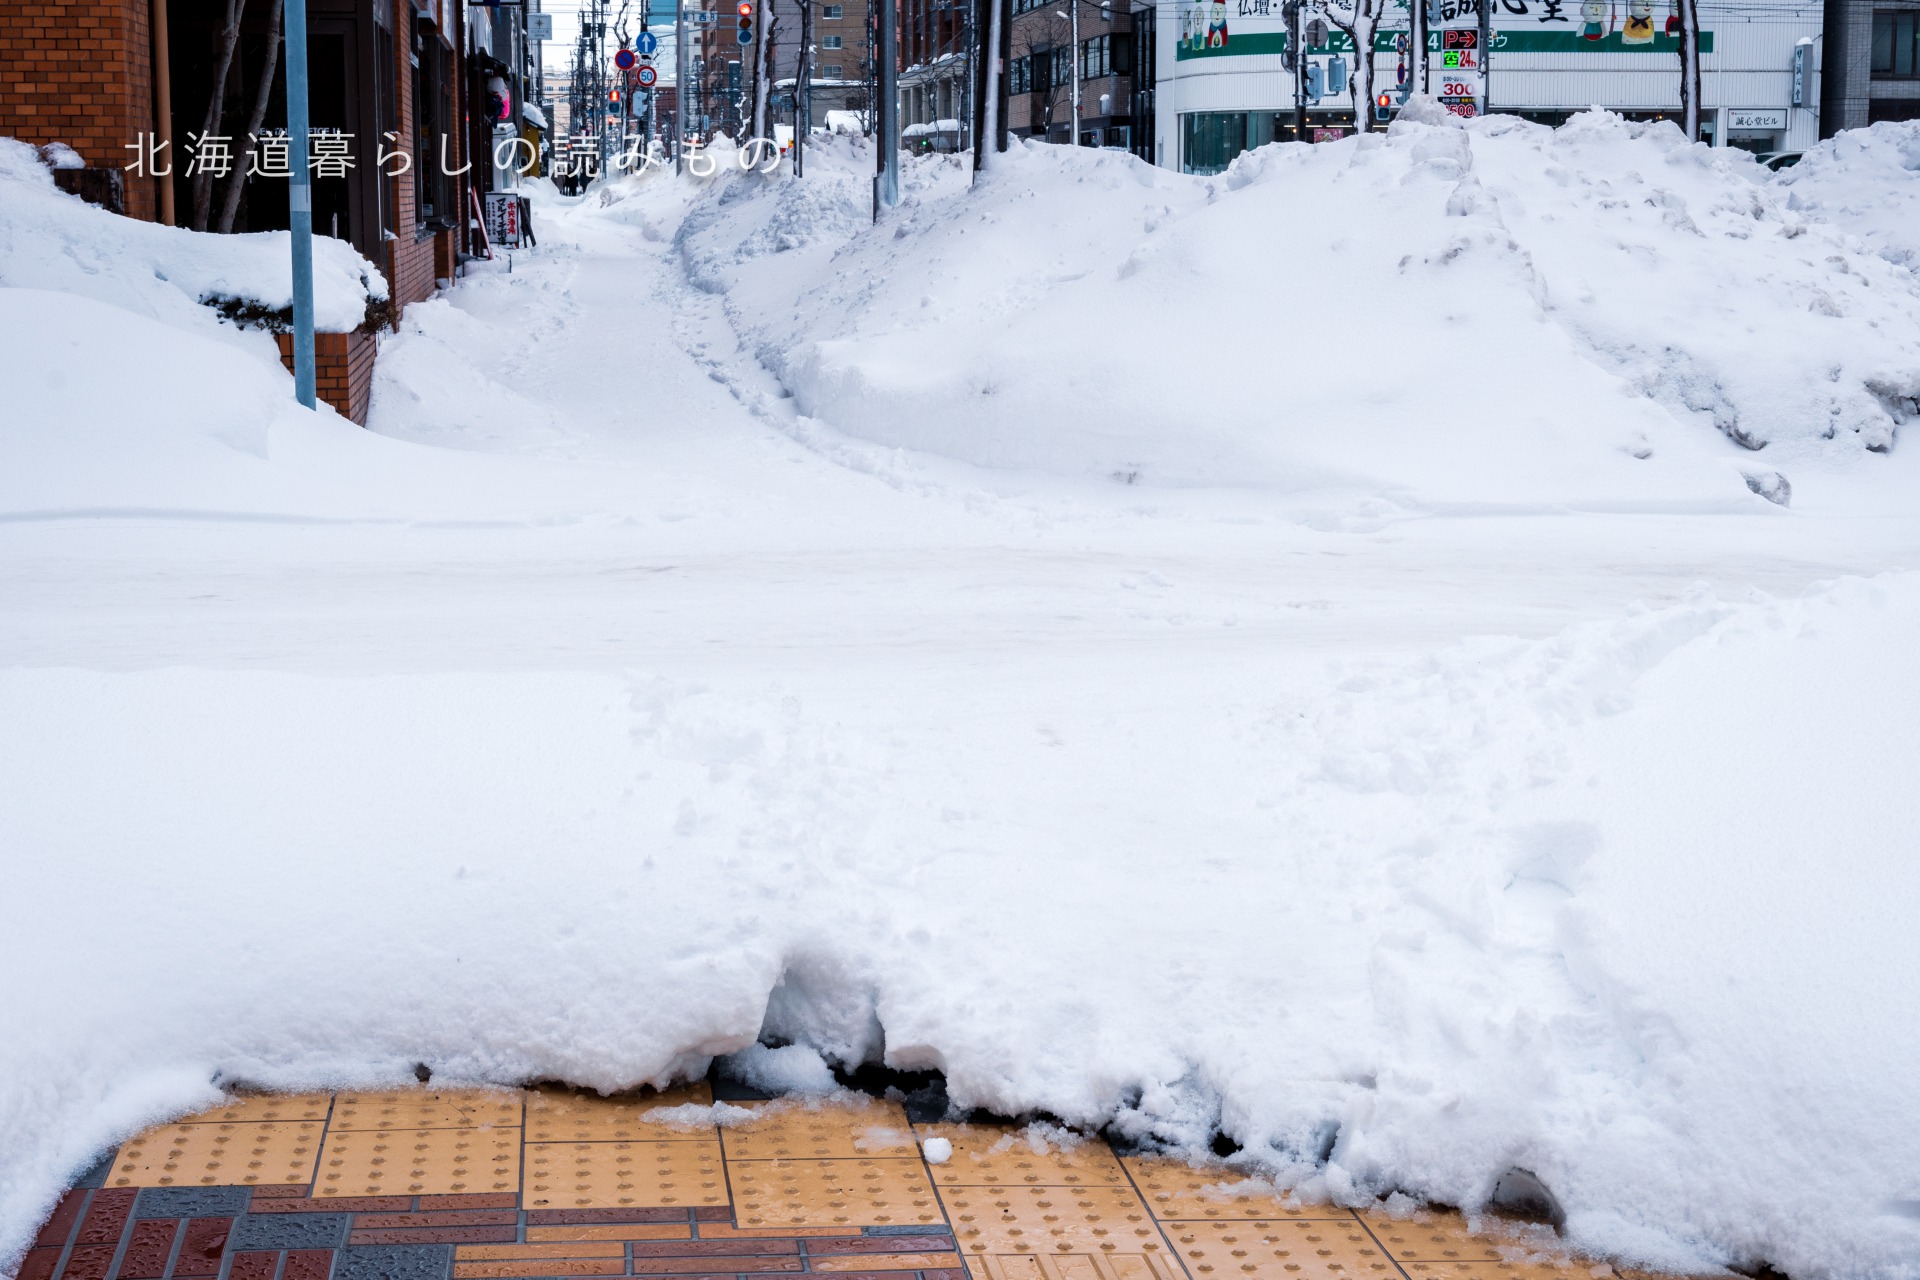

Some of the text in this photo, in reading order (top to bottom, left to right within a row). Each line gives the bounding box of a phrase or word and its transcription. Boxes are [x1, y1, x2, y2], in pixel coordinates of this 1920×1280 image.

[1445, 31, 1459, 49] P
[1444, 50, 1459, 68] 空
[1459, 50, 1477, 68] 24h
[640, 71, 653, 82] 50
[1735, 116, 1779, 126] 誠心堂ビル
